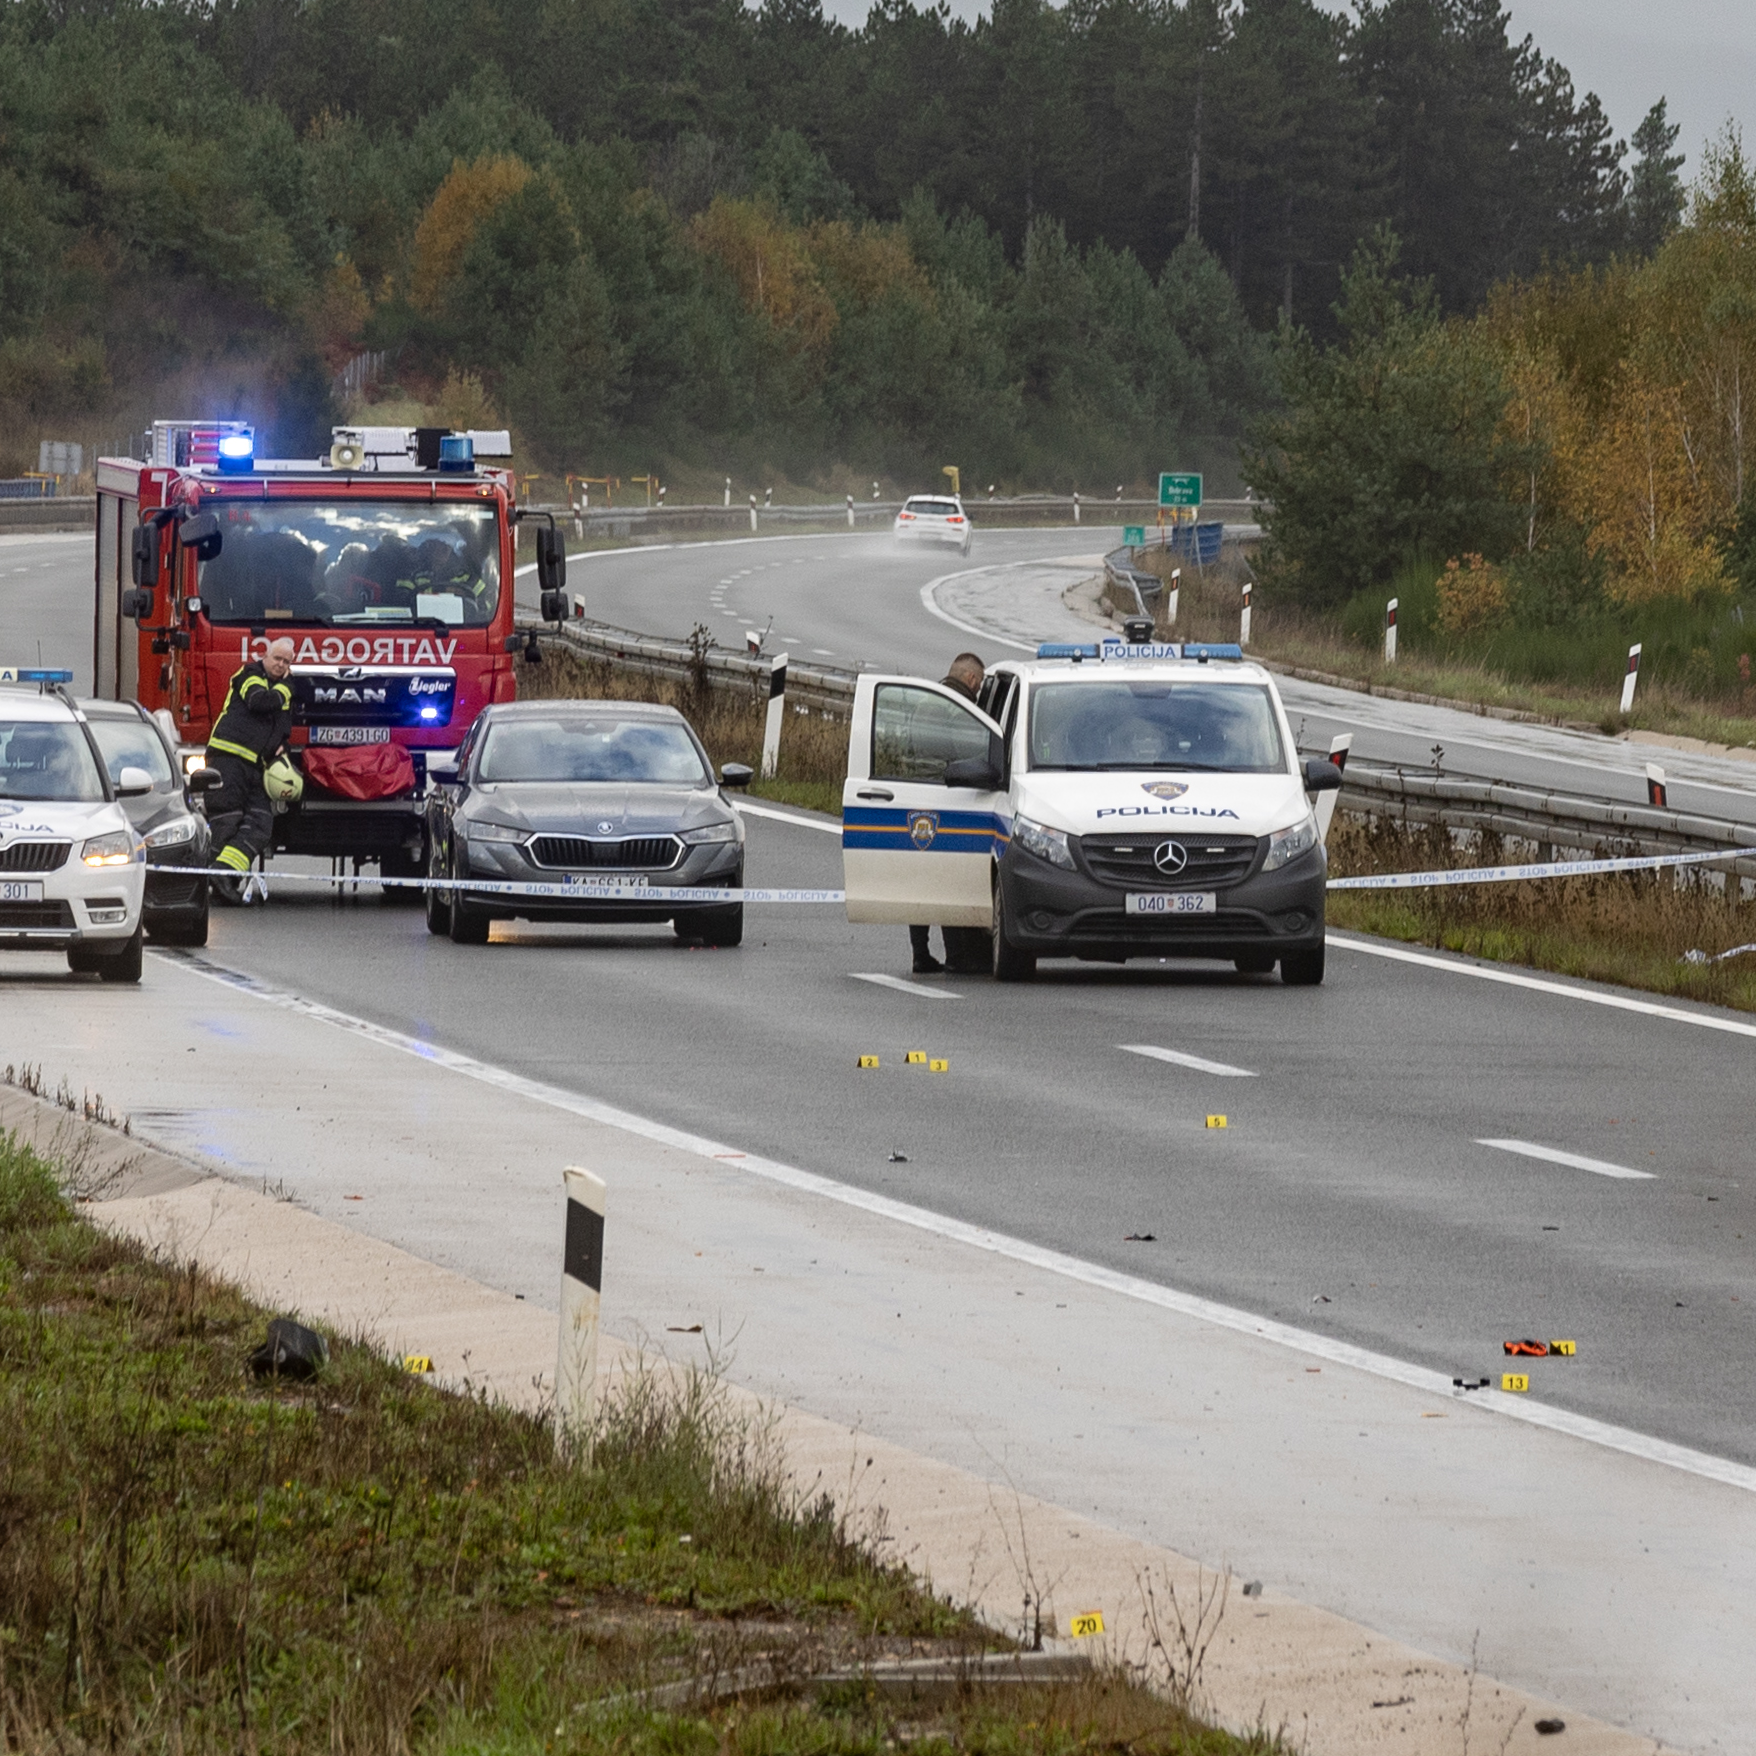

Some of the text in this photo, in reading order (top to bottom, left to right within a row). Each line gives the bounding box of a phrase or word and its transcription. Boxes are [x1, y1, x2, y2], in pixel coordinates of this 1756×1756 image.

[1104, 645, 1176, 659] POLICIJA
[314, 687, 386, 703] MAN
[318, 728, 334, 742] ZG
[1097, 805, 1240, 820] POLICIJA
[3, 884, 29, 899] 301
[1138, 895, 1204, 911] 040 362
[866, 1057, 873, 1067] 2
[915, 1053, 920, 1062] 1
[935, 1061, 942, 1070] 3
[1508, 1376, 1524, 1390] 13
[1076, 1618, 1097, 1635] 20
